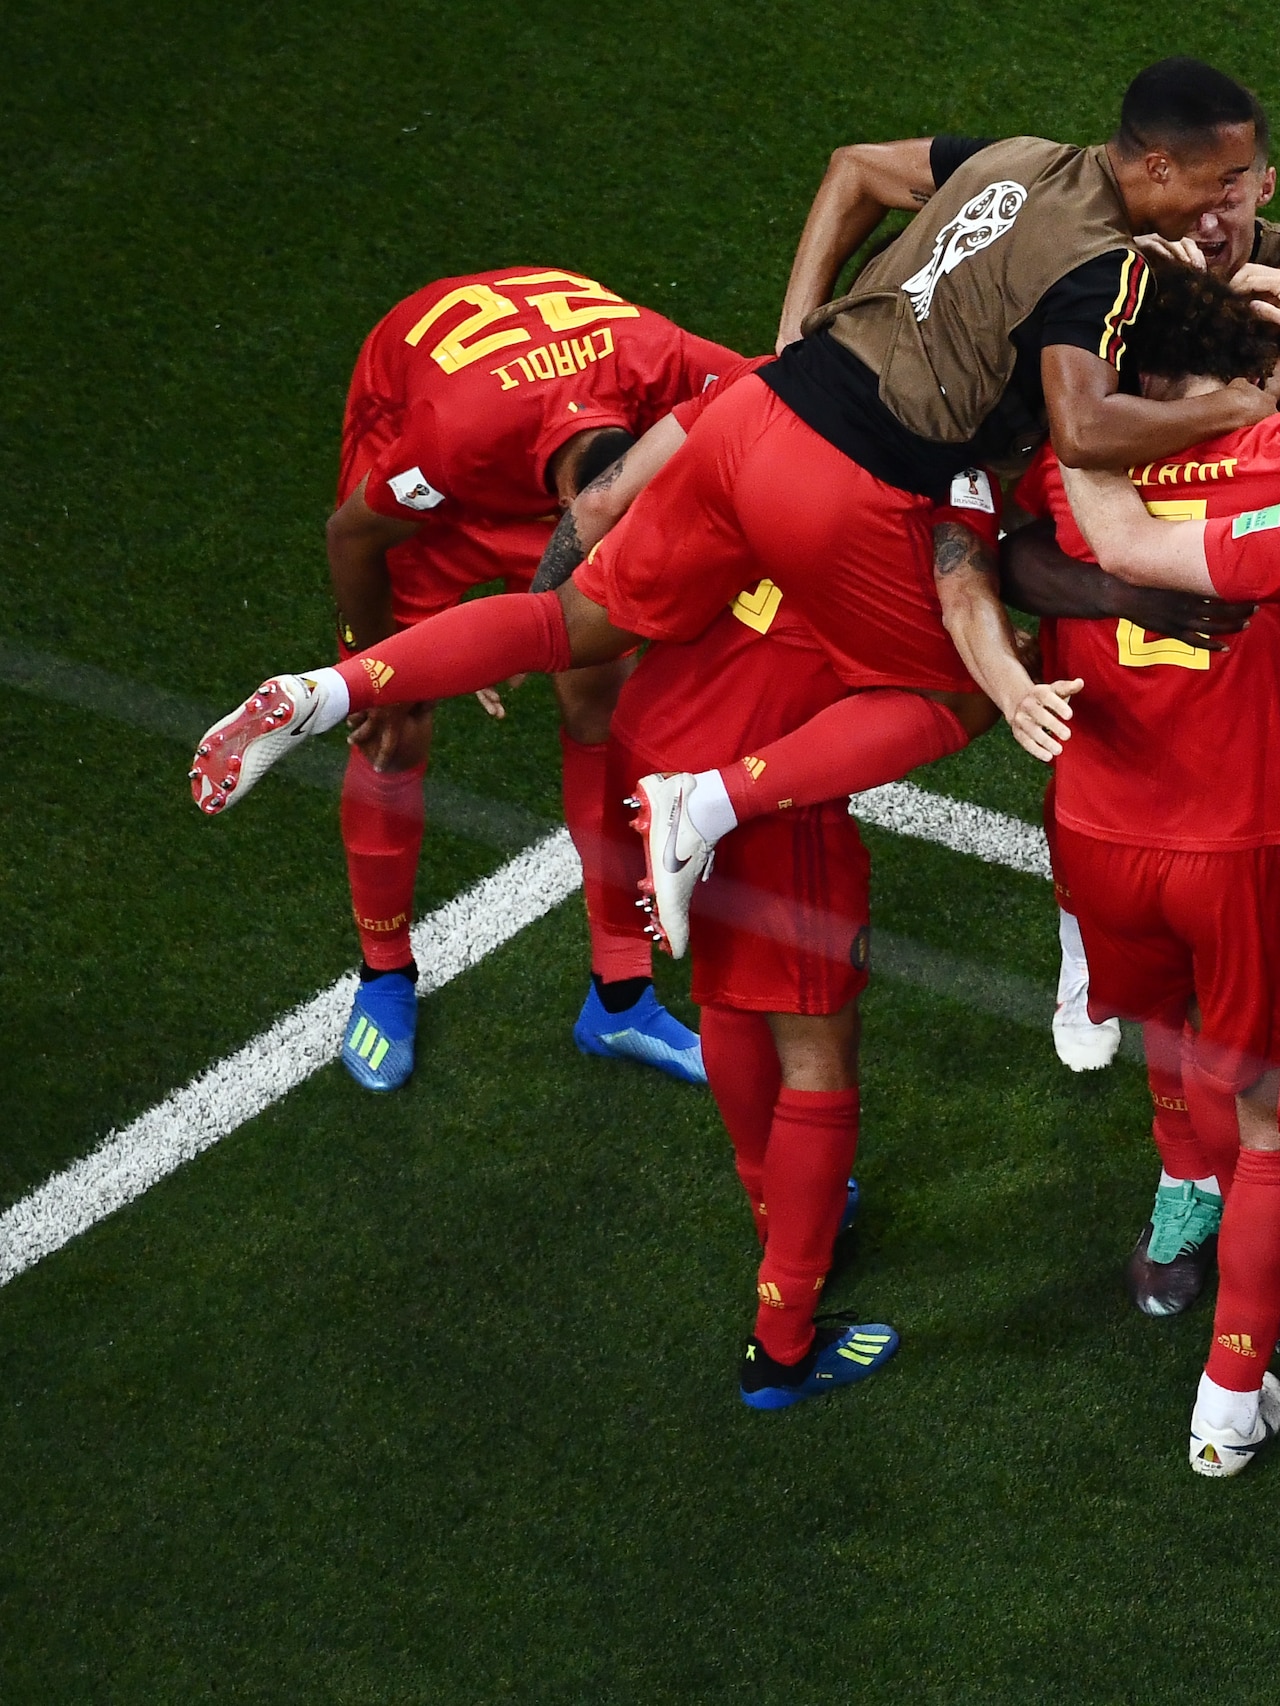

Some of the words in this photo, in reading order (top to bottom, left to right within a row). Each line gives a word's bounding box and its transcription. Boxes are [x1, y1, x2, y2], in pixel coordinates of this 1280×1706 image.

[404, 269, 640, 374] 22
[490, 327, 615, 391] CHADLI
[1217, 1336, 1257, 1358] adidas
